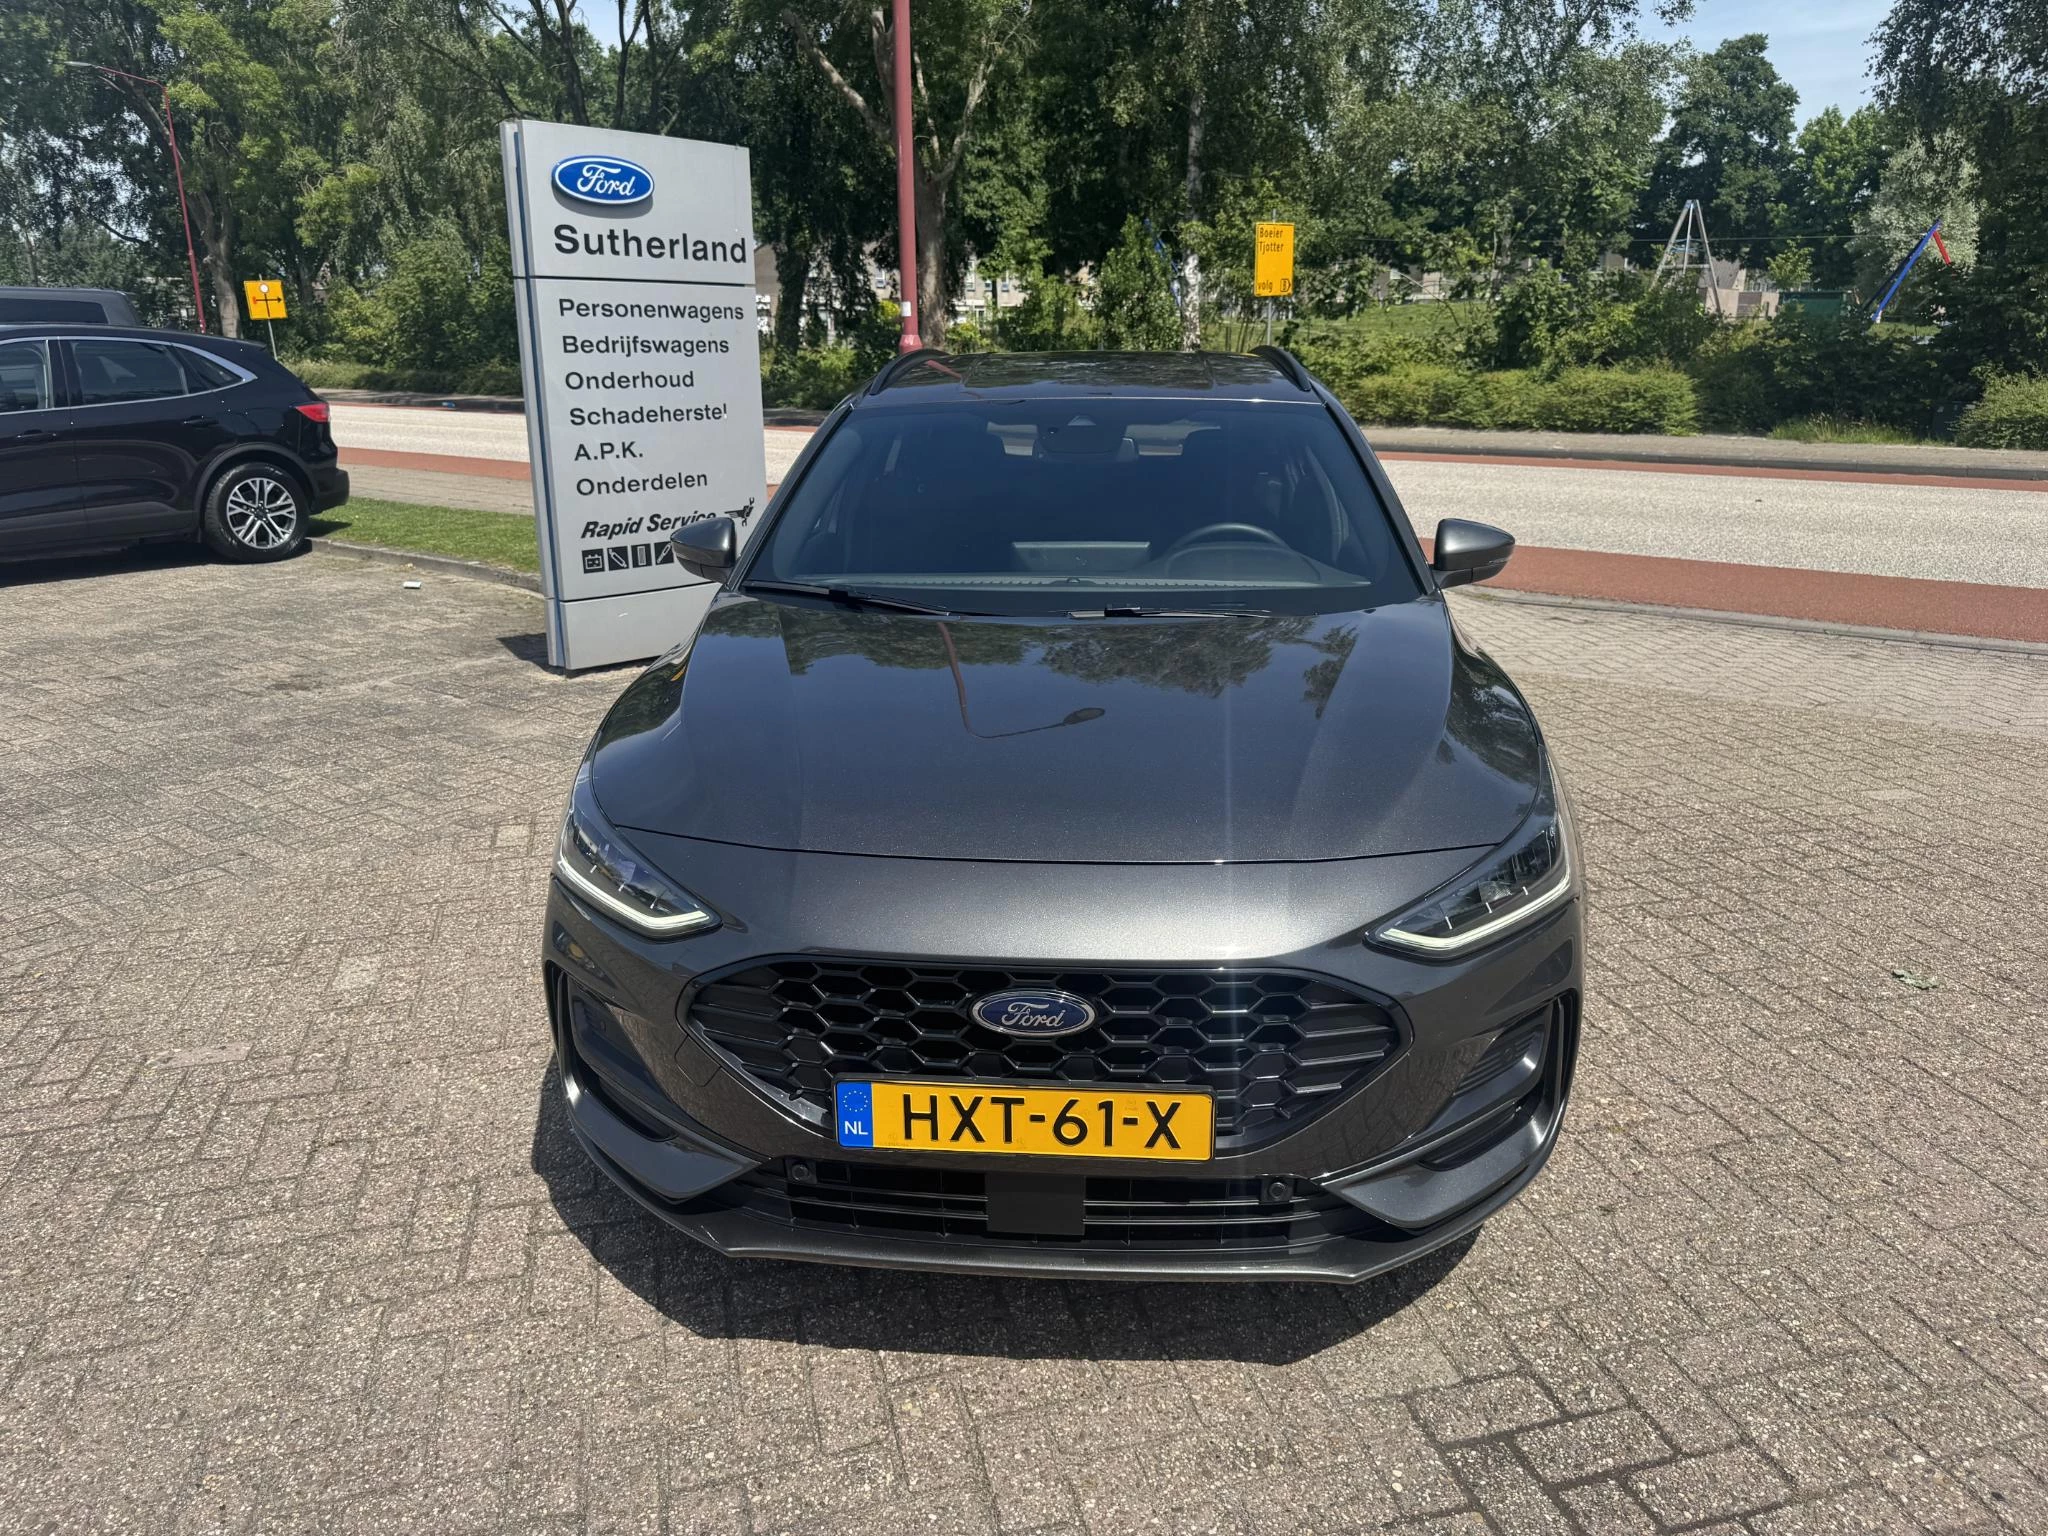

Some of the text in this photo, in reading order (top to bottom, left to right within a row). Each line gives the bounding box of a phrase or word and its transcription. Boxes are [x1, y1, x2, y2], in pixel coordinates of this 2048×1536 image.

[576, 163, 635, 196] Ford
[553, 224, 747, 263] Sutherland
[1259, 227, 1283, 238] Boeier
[1258, 241, 1284, 255] Tjotter
[558, 298, 744, 323] Personenwagens
[562, 335, 729, 357] Bedrijfswagens
[565, 371, 694, 390] Onderhoud
[574, 441, 643, 461] A.P.K.
[576, 472, 708, 496] Onderdelen
[580, 516, 643, 540] Rapid
[1001, 1001, 1066, 1026] Ford
[844, 1093, 1182, 1150] NL HXT-61-X
